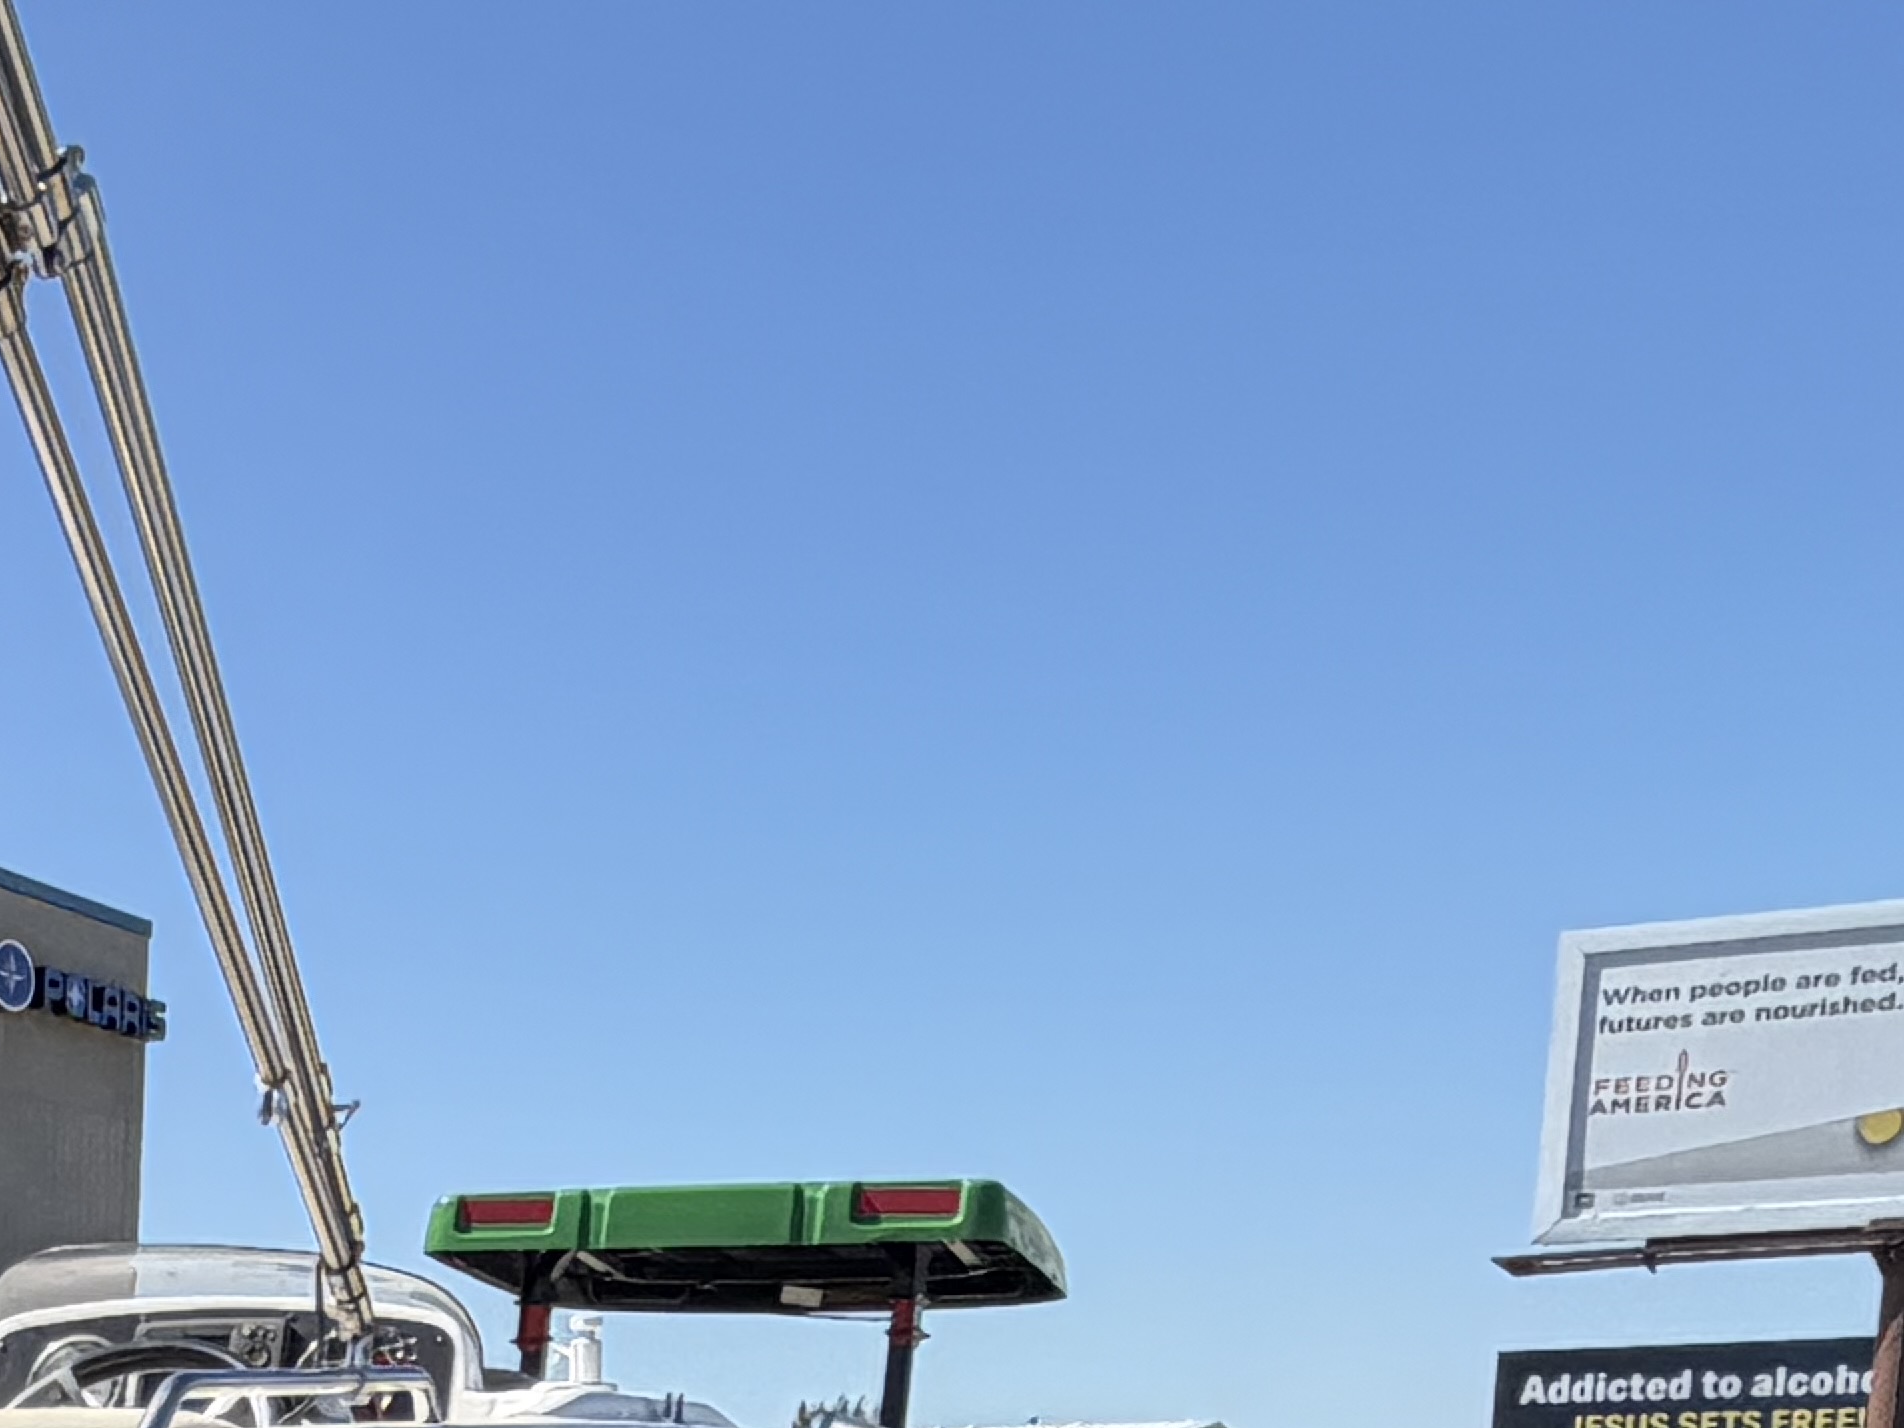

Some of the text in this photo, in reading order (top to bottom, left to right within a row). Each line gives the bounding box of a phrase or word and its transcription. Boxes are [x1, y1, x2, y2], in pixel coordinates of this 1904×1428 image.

[1602, 962, 1904, 1006] When people are fed,
[1598, 992, 1904, 1034] futures are nourished.
[1593, 1058, 1729, 1096] FEEDING
[1589, 1090, 1727, 1116] AMERICA
[1519, 1368, 1692, 1406] Addicted
[1702, 1370, 1742, 1400] to
